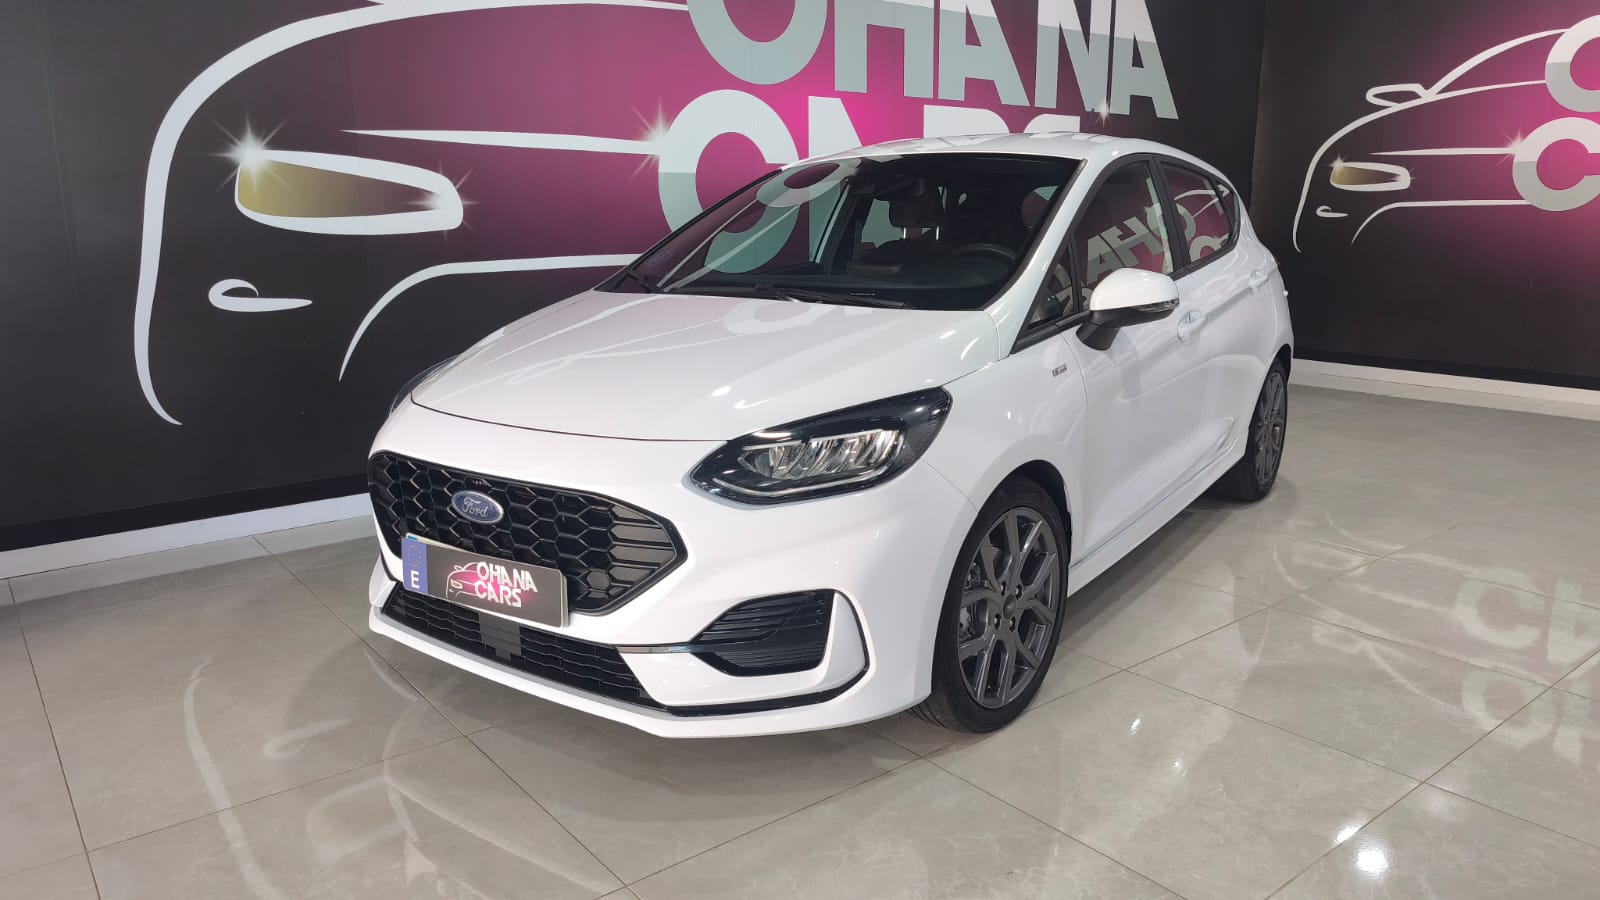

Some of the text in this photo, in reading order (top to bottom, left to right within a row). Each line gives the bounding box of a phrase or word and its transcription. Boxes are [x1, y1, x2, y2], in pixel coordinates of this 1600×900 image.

[462, 497, 489, 518] Ford
[410, 570, 420, 589] E
[476, 561, 538, 592] OHANA
[474, 580, 522, 608] CARS
